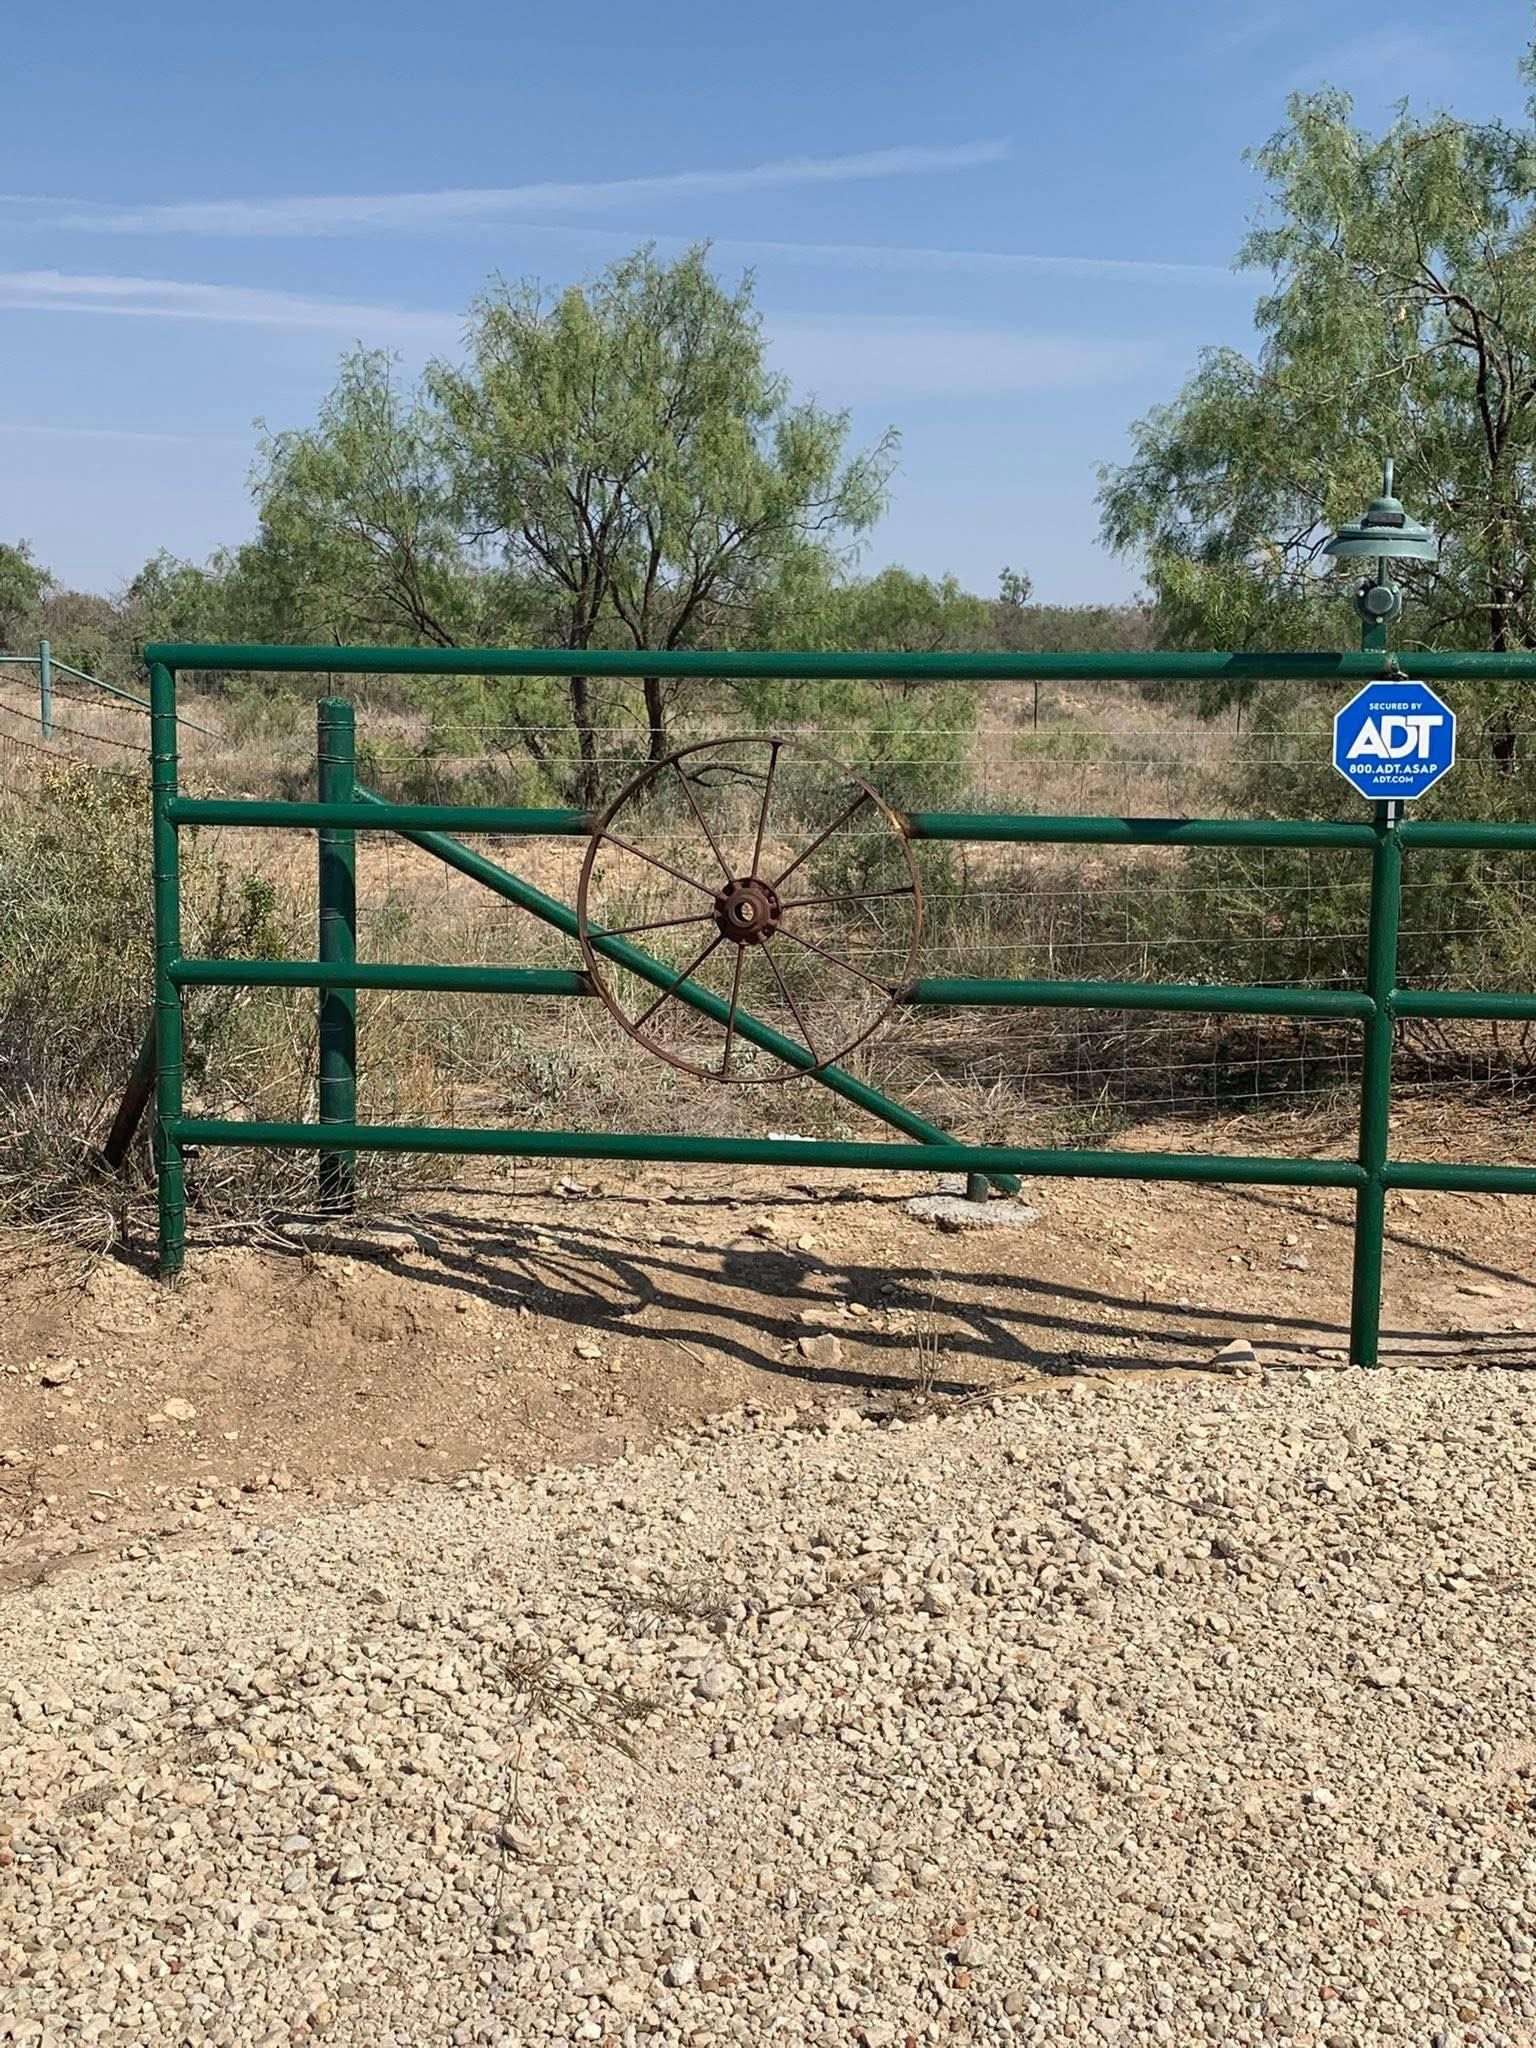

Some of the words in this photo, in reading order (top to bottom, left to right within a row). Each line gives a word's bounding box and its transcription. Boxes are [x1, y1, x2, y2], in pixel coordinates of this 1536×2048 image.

[1369, 702, 1409, 710] SECURED
[1411, 702, 1422, 710] BY
[1346, 715, 1443, 759] ADT
[1349, 764, 1438, 774] 800.ADT.ASAP
[1372, 775, 1414, 783] ADT.COM
